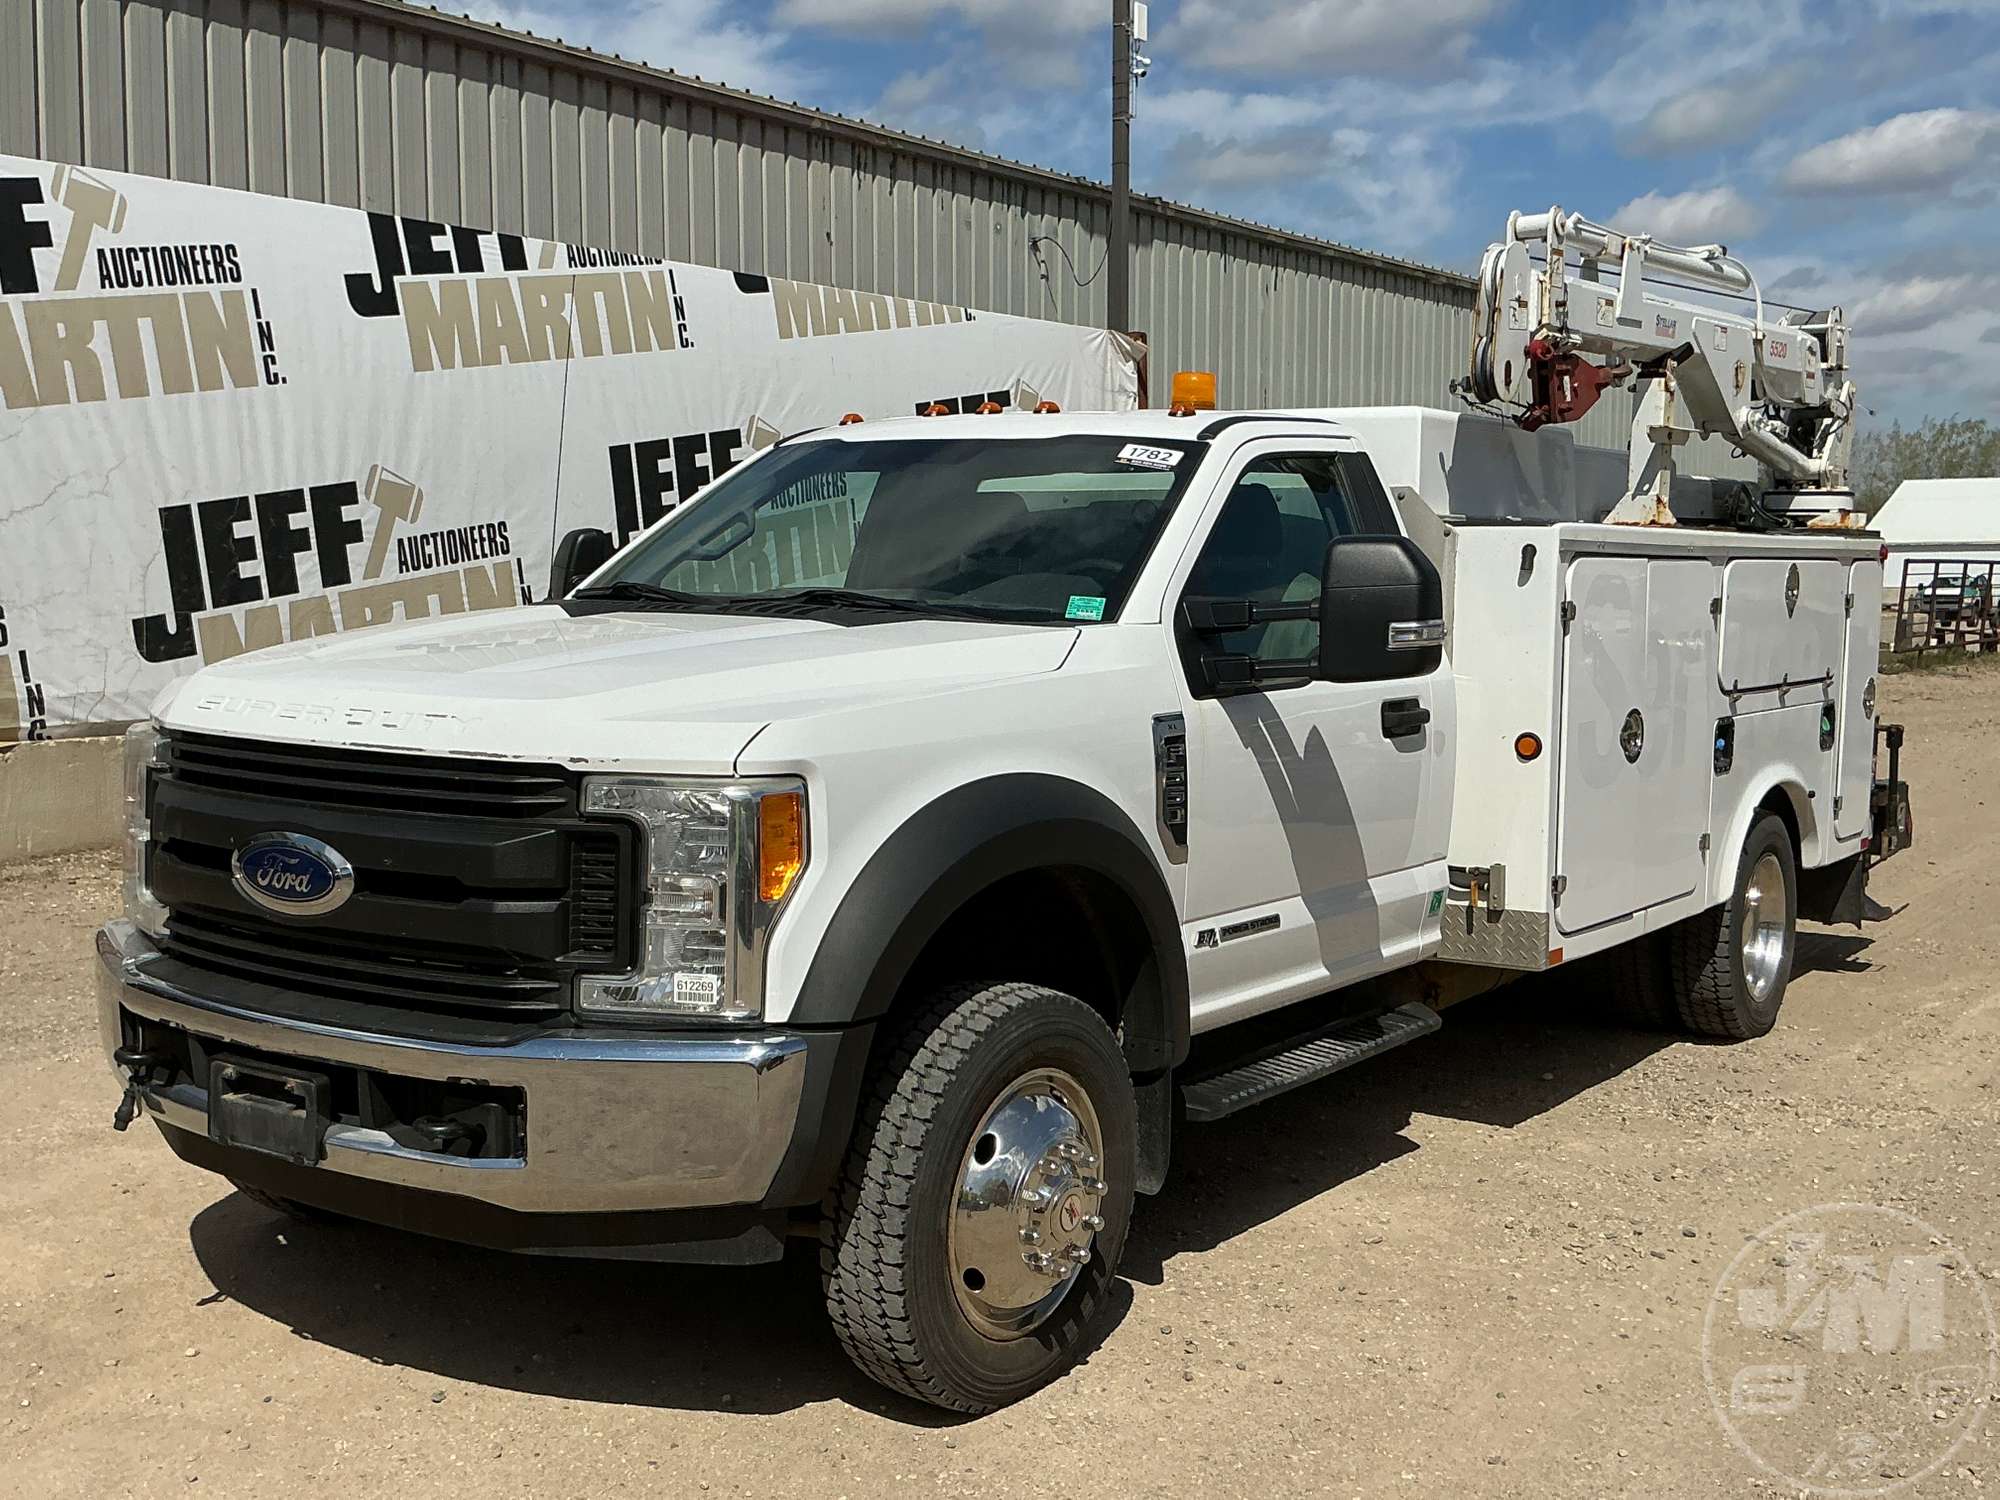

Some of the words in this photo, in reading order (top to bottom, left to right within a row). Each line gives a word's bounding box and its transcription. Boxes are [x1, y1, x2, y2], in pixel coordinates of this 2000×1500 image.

[97, 244, 242, 289] AUCTIONEERS
[399, 270, 677, 373] MARTIN
[1769, 340, 1788, 360] 5520
[1129, 447, 1173, 462] 1782
[398, 520, 511, 574] AUCTIONEERS
[132, 481, 364, 663] JEFF
[256, 852, 315, 893] Ford
[677, 980, 714, 992] 612269
